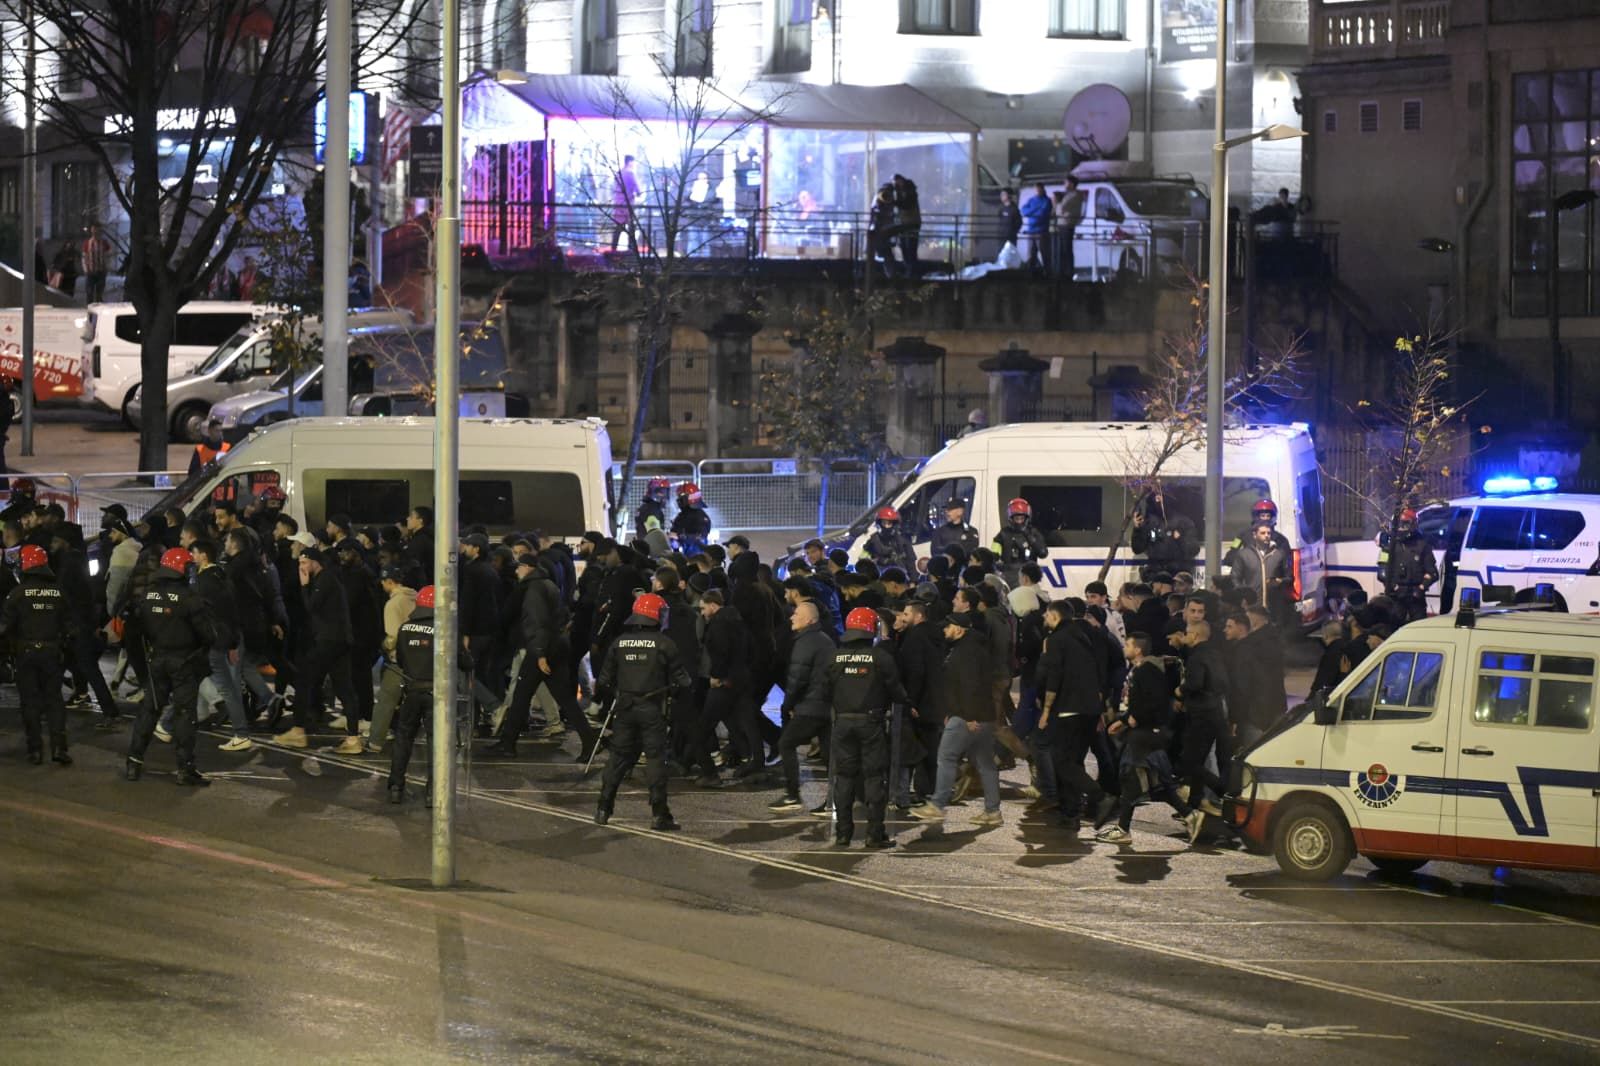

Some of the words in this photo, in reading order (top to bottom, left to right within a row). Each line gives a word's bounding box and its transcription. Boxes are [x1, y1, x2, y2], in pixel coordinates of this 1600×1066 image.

[43, 369, 62, 384] 720
[618, 639, 656, 648] ERTZAINTZA
[1353, 788, 1402, 809] ERTZAINTZA
